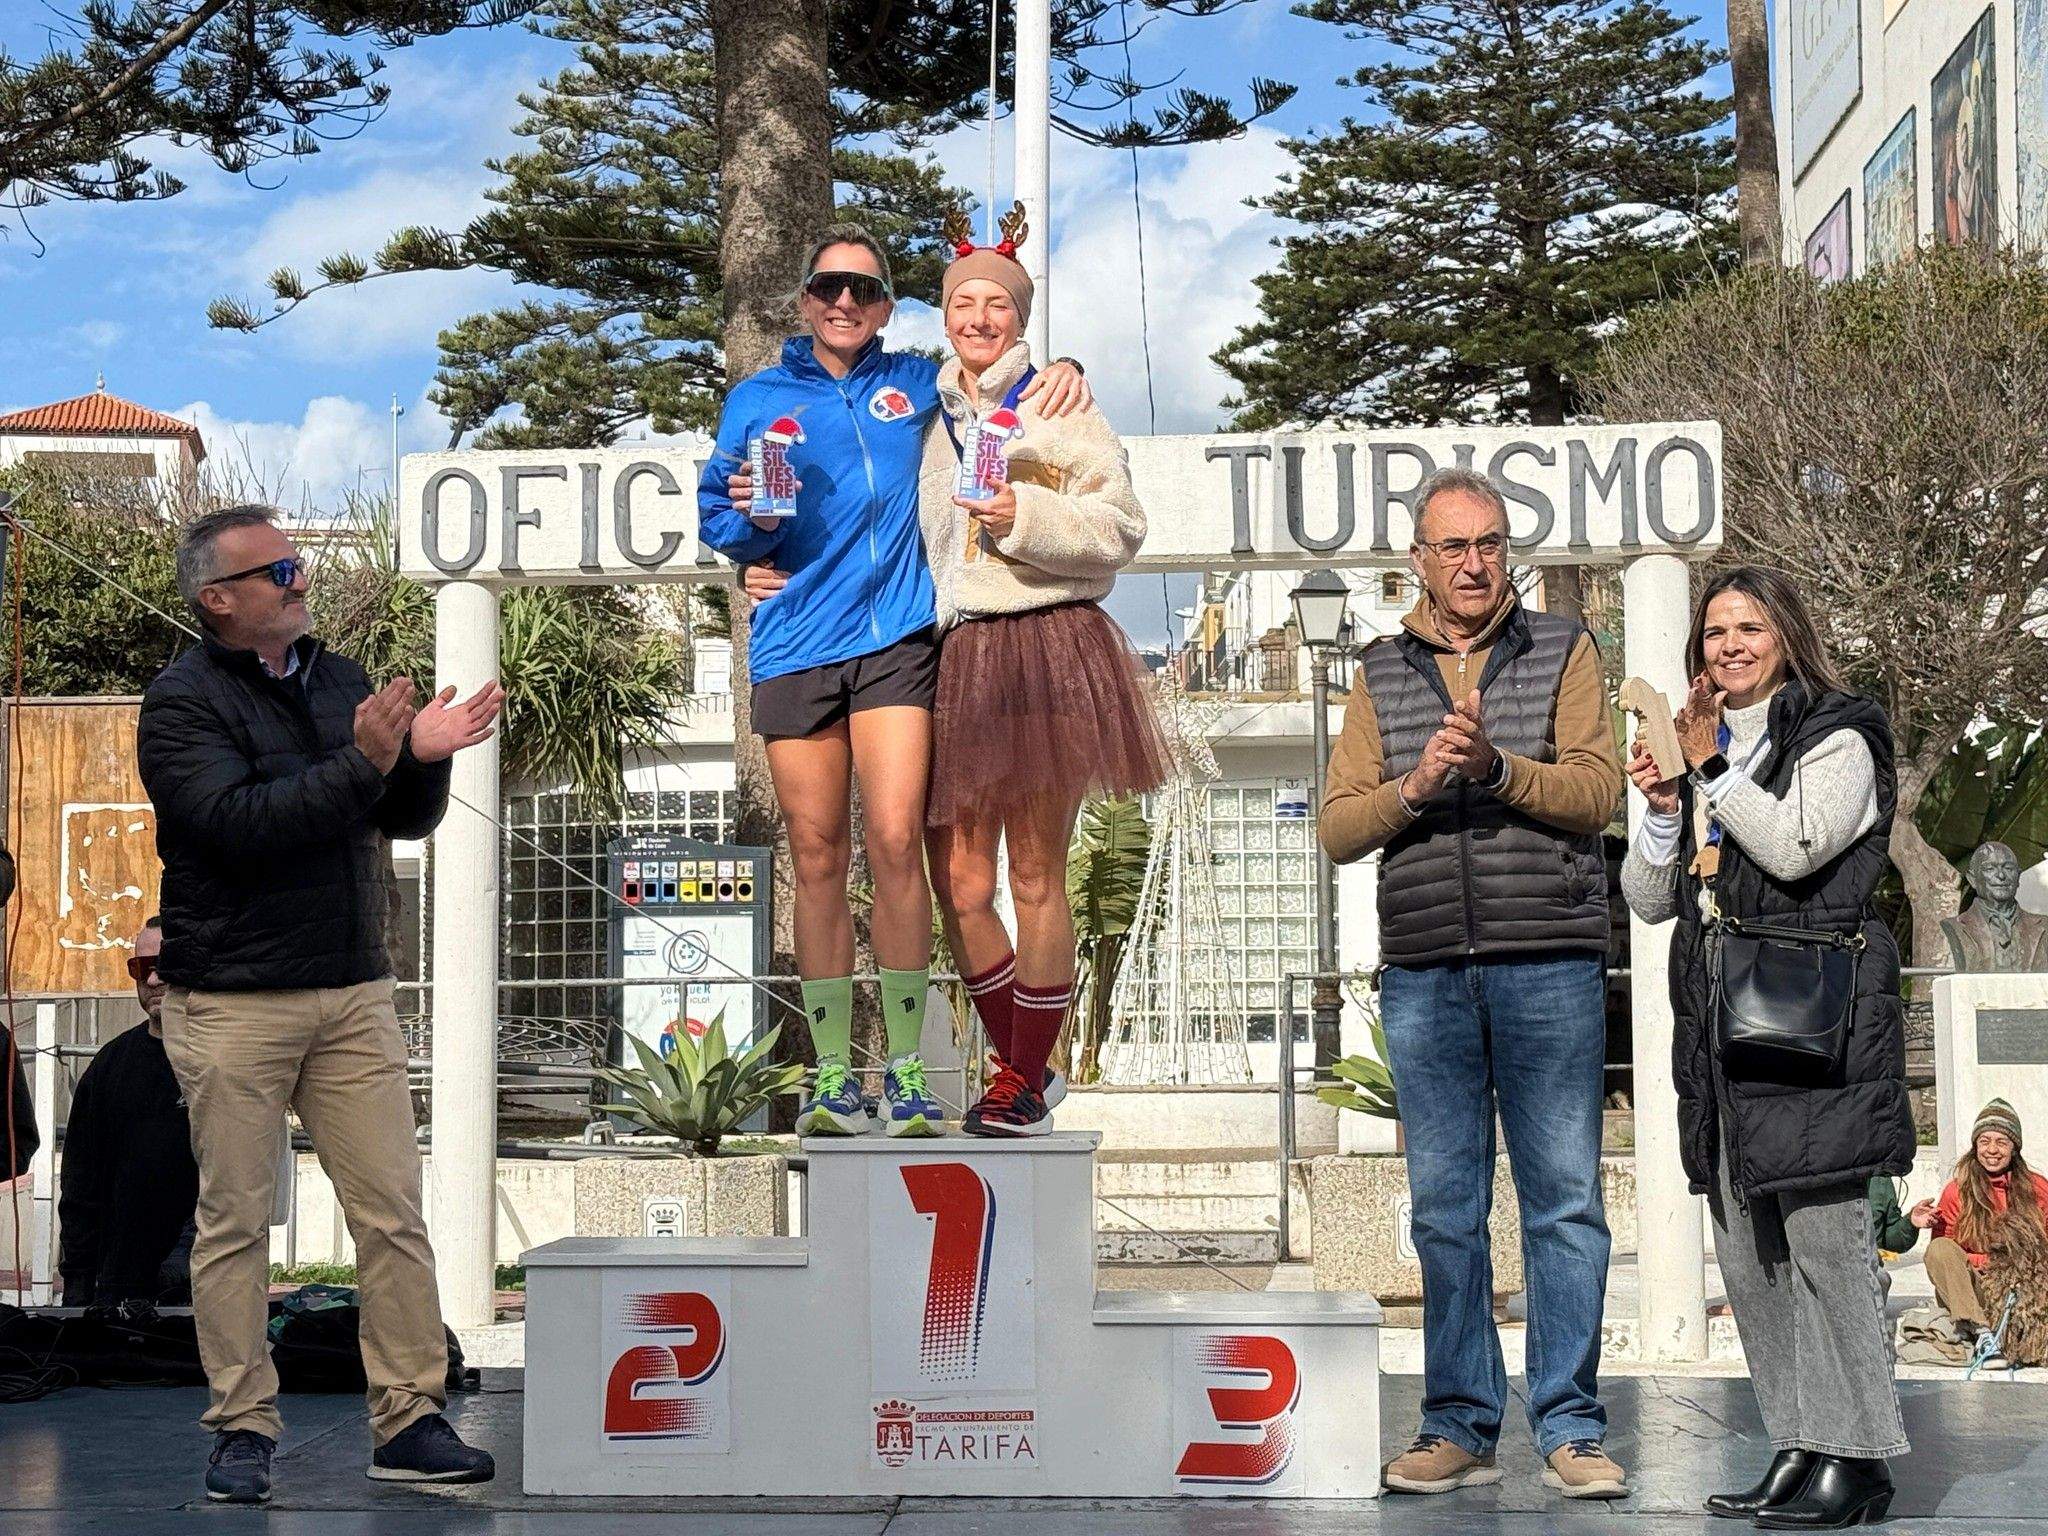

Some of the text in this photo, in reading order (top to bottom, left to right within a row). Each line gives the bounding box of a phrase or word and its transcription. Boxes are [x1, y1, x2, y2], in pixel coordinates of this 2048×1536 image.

[977, 442, 1000, 458] SIL
[751, 438, 763, 486] CARRERA
[763, 451, 786, 466] SIL
[764, 466, 793, 482] VES
[976, 459, 1005, 475] VES
[764, 481, 794, 498] TRE
[898, 1163, 998, 1383] 1
[604, 1291, 725, 1442] 2
[973, 1412, 987, 1421] DE
[988, 1411, 1031, 1421] DEPORTES
[1174, 1335, 1303, 1486] 3
[952, 1424, 1020, 1432] AYUNTAMIENTO
[915, 1433, 1035, 1461] TARIFA
